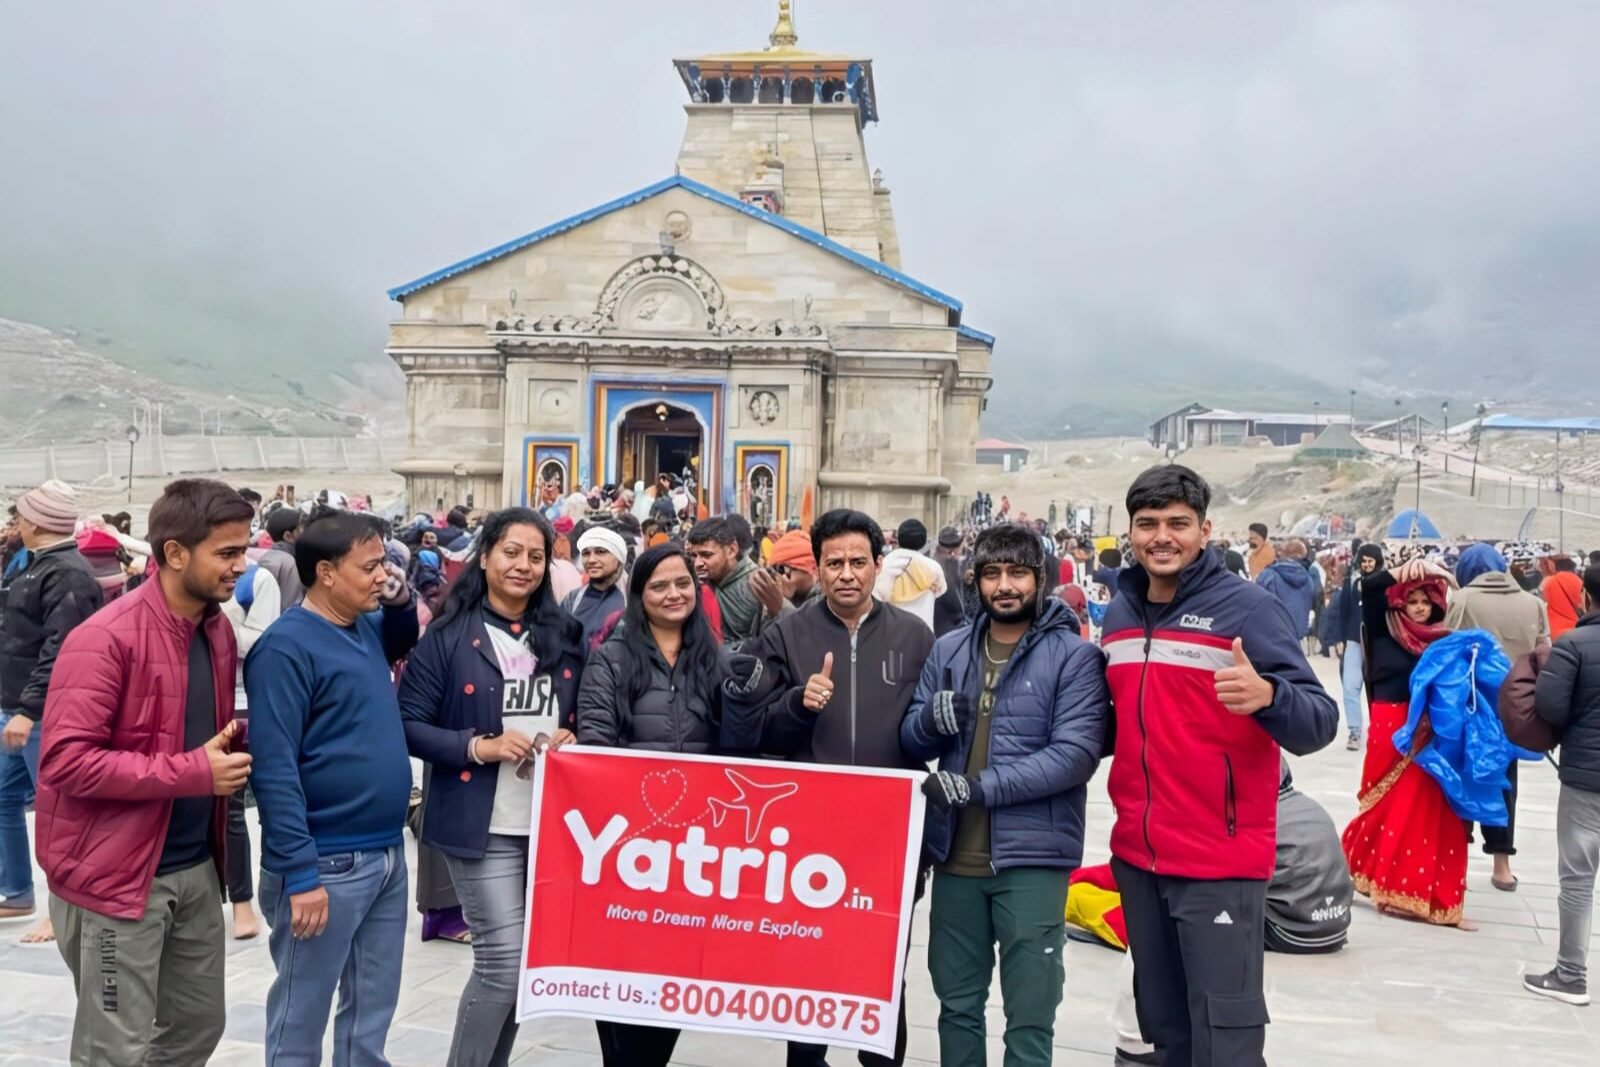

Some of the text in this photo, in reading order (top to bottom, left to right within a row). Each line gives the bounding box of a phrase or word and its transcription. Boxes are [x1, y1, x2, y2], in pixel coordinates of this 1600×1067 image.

[605, 903, 823, 940] More Dream More Explore
[530, 977, 611, 1001] Contact
[658, 981, 881, 1036] 8004000875
